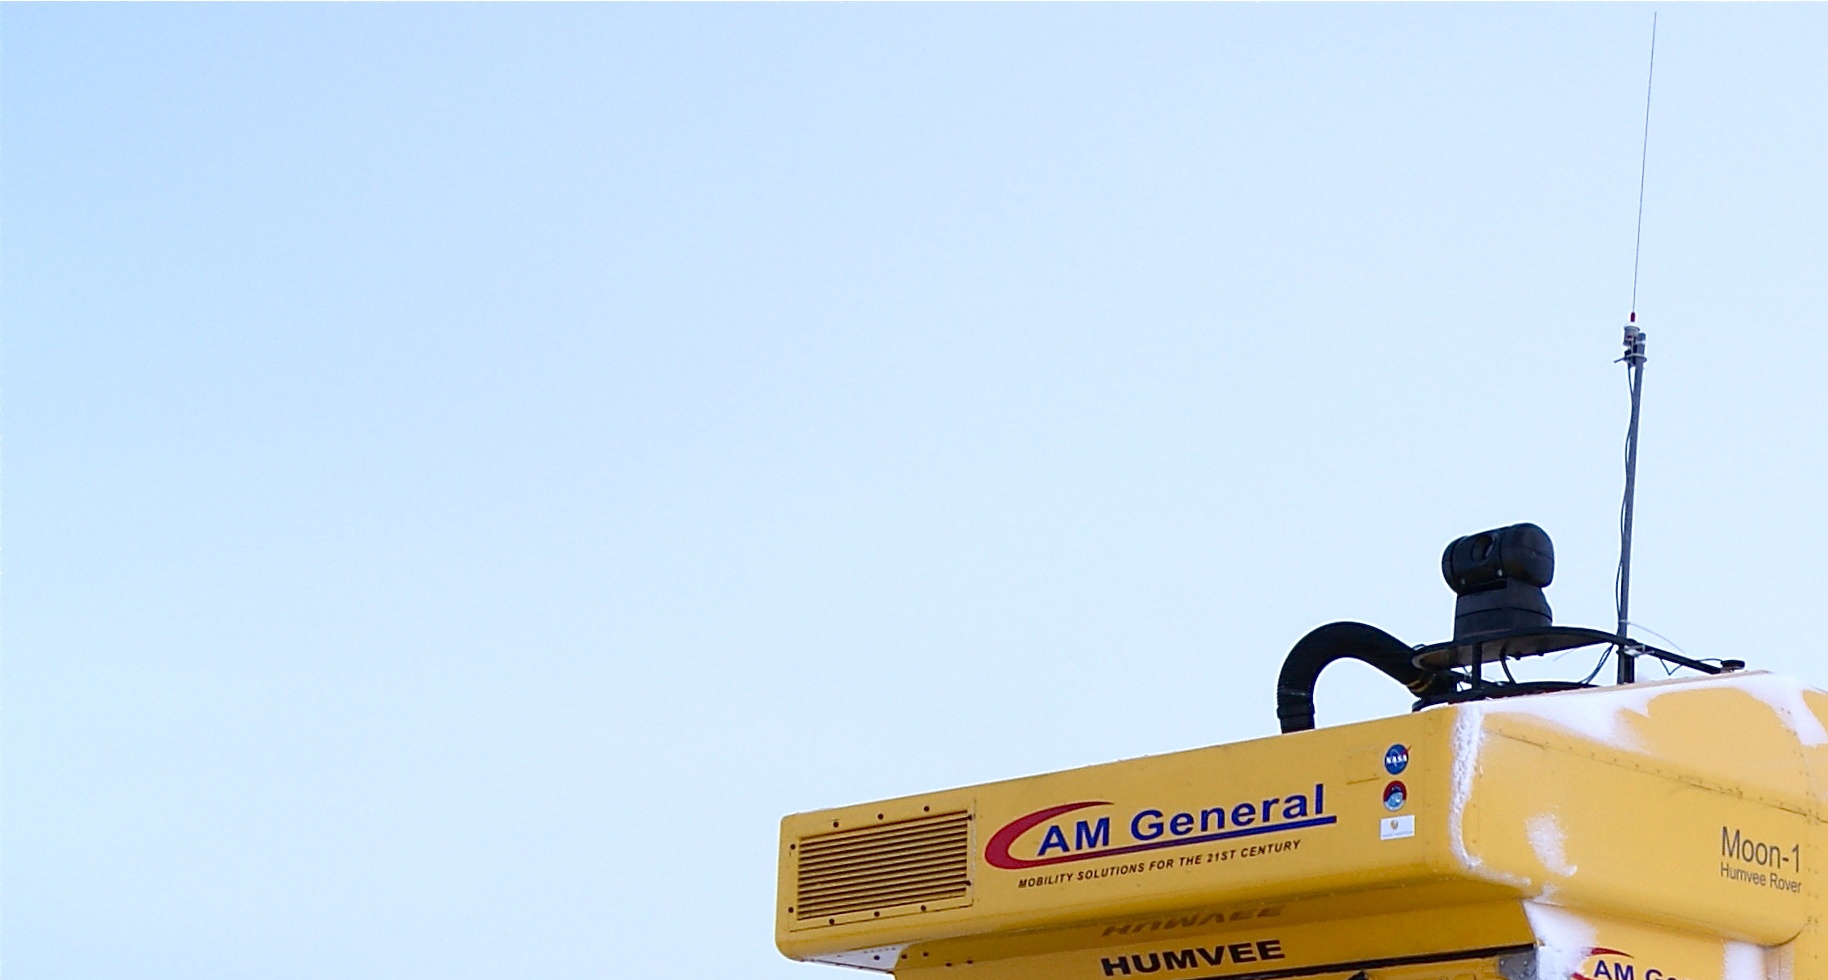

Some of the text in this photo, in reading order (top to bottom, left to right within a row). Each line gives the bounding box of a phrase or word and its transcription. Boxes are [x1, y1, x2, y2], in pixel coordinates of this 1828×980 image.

[1037, 816, 1110, 857] AM
[1131, 783, 1324, 841] General
[1018, 839, 1301, 888] MOBILITY SOLUTIONS FOR THE 21ST CENTURY
[1722, 826, 1799, 873] Moon-1
[1720, 862, 1802, 893] Humvee Rover
[1101, 939, 1285, 977] HUMVEE
